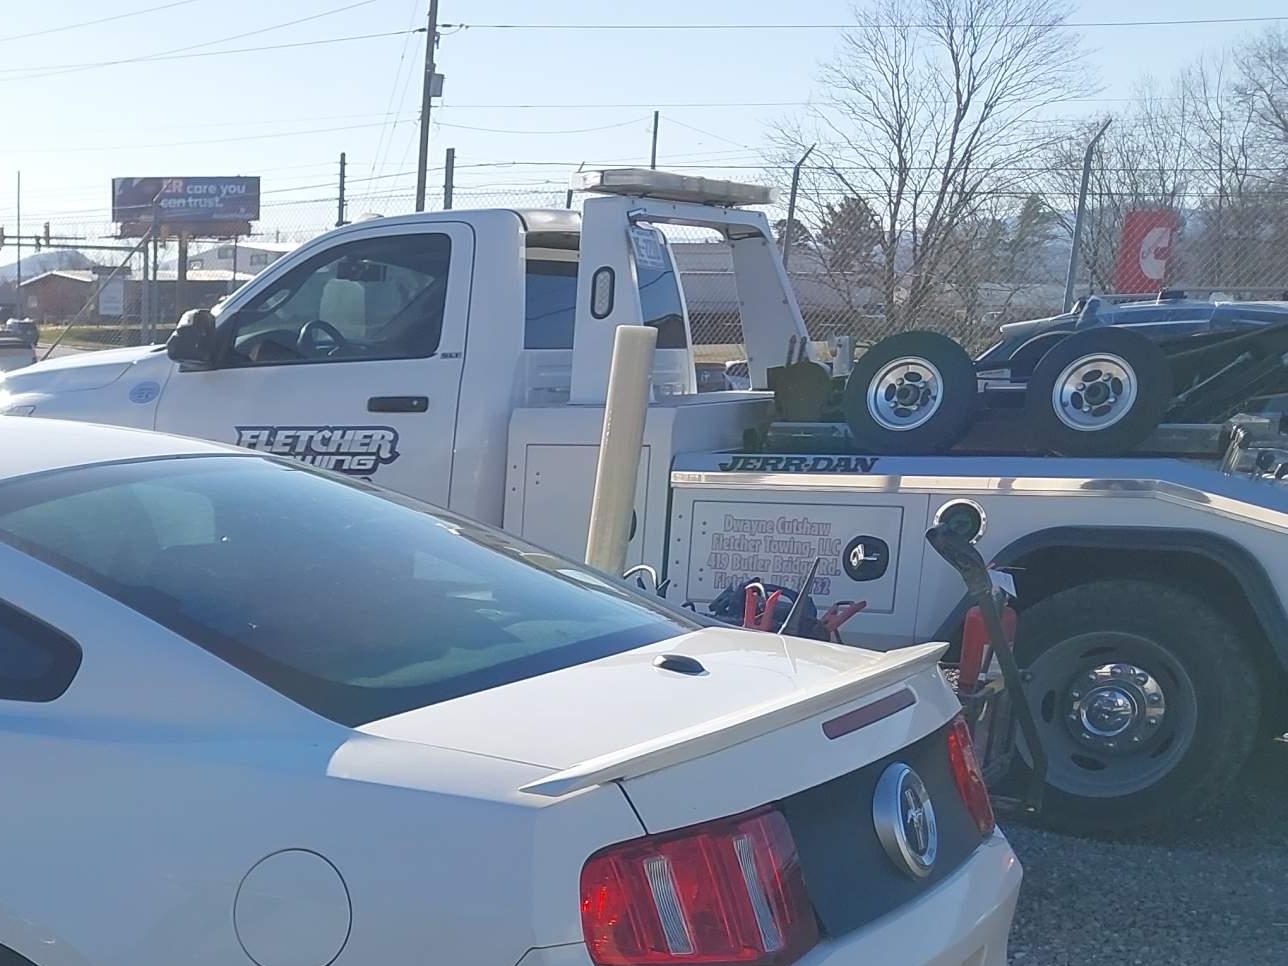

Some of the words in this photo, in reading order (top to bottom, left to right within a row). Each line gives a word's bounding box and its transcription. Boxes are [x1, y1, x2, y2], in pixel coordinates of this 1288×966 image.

[162, 179, 183, 193] ER
[186, 184, 217, 194] care
[220, 184, 246, 198] you
[187, 196, 223, 208] trust.
[238, 429, 394, 460] FLETCHER
[723, 514, 774, 536] Dwayne
[776, 516, 831, 537] Cutshaw
[712, 533, 762, 553] Fletcher
[763, 535, 816, 558] Towing,
[817, 538, 841, 556] LLC
[707, 552, 730, 570] 419
[731, 554, 771, 572] Butler
[817, 558, 842, 576] Rd.
